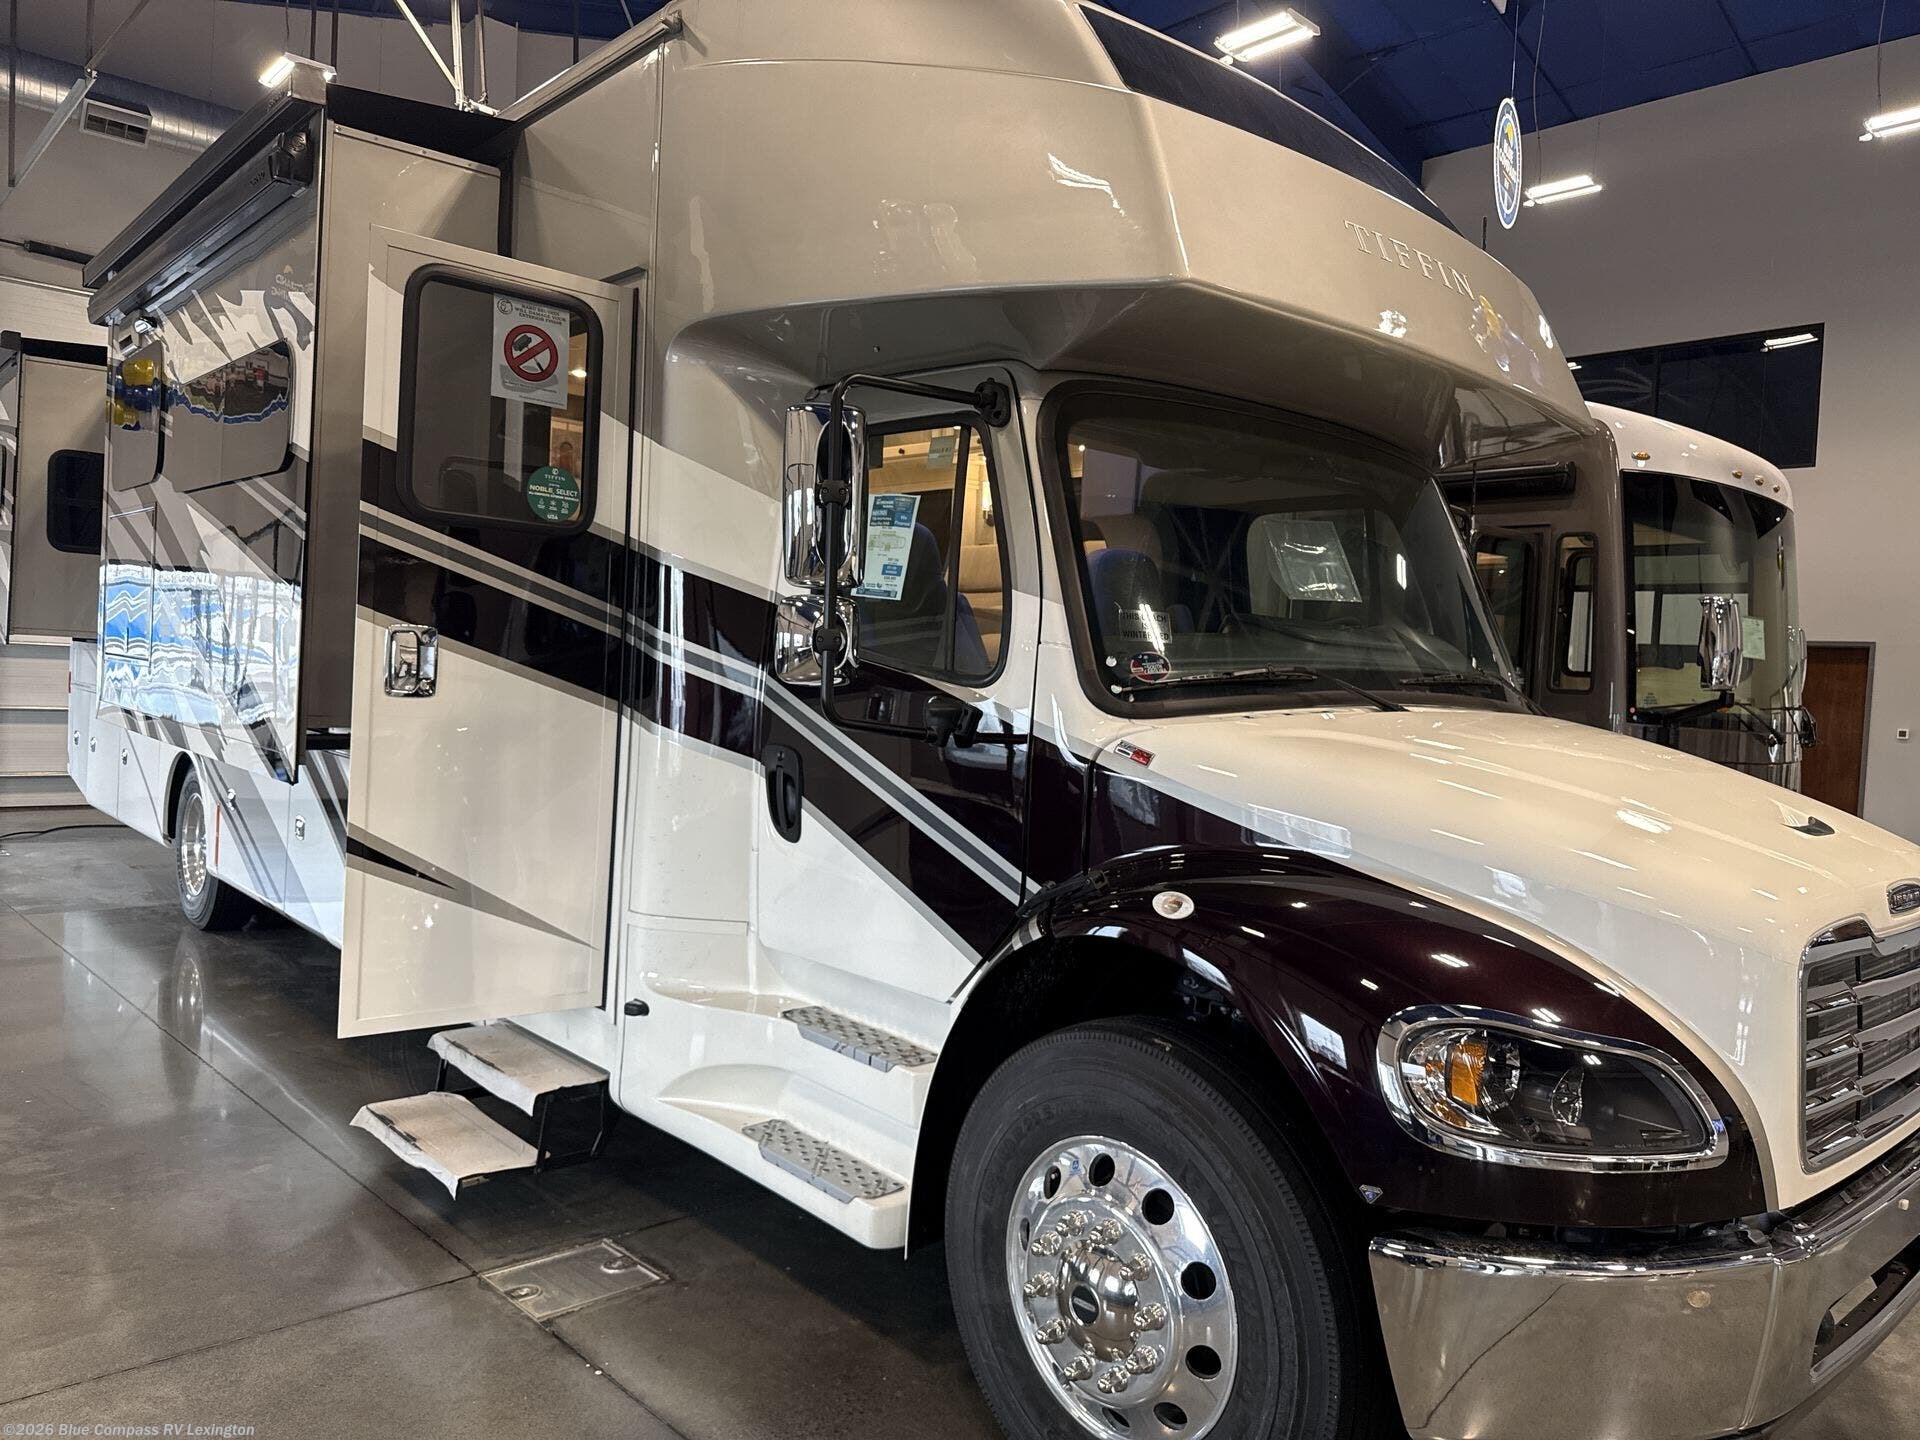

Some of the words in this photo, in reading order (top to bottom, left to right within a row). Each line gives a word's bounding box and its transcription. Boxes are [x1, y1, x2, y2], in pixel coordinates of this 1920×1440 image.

[1344, 219, 1475, 301] TIFFIN
[544, 473, 566, 481] TIFFIN
[529, 484, 554, 494] NOBLE
[556, 488, 578, 497] SELECT
[1121, 611, 1139, 621] THIS
